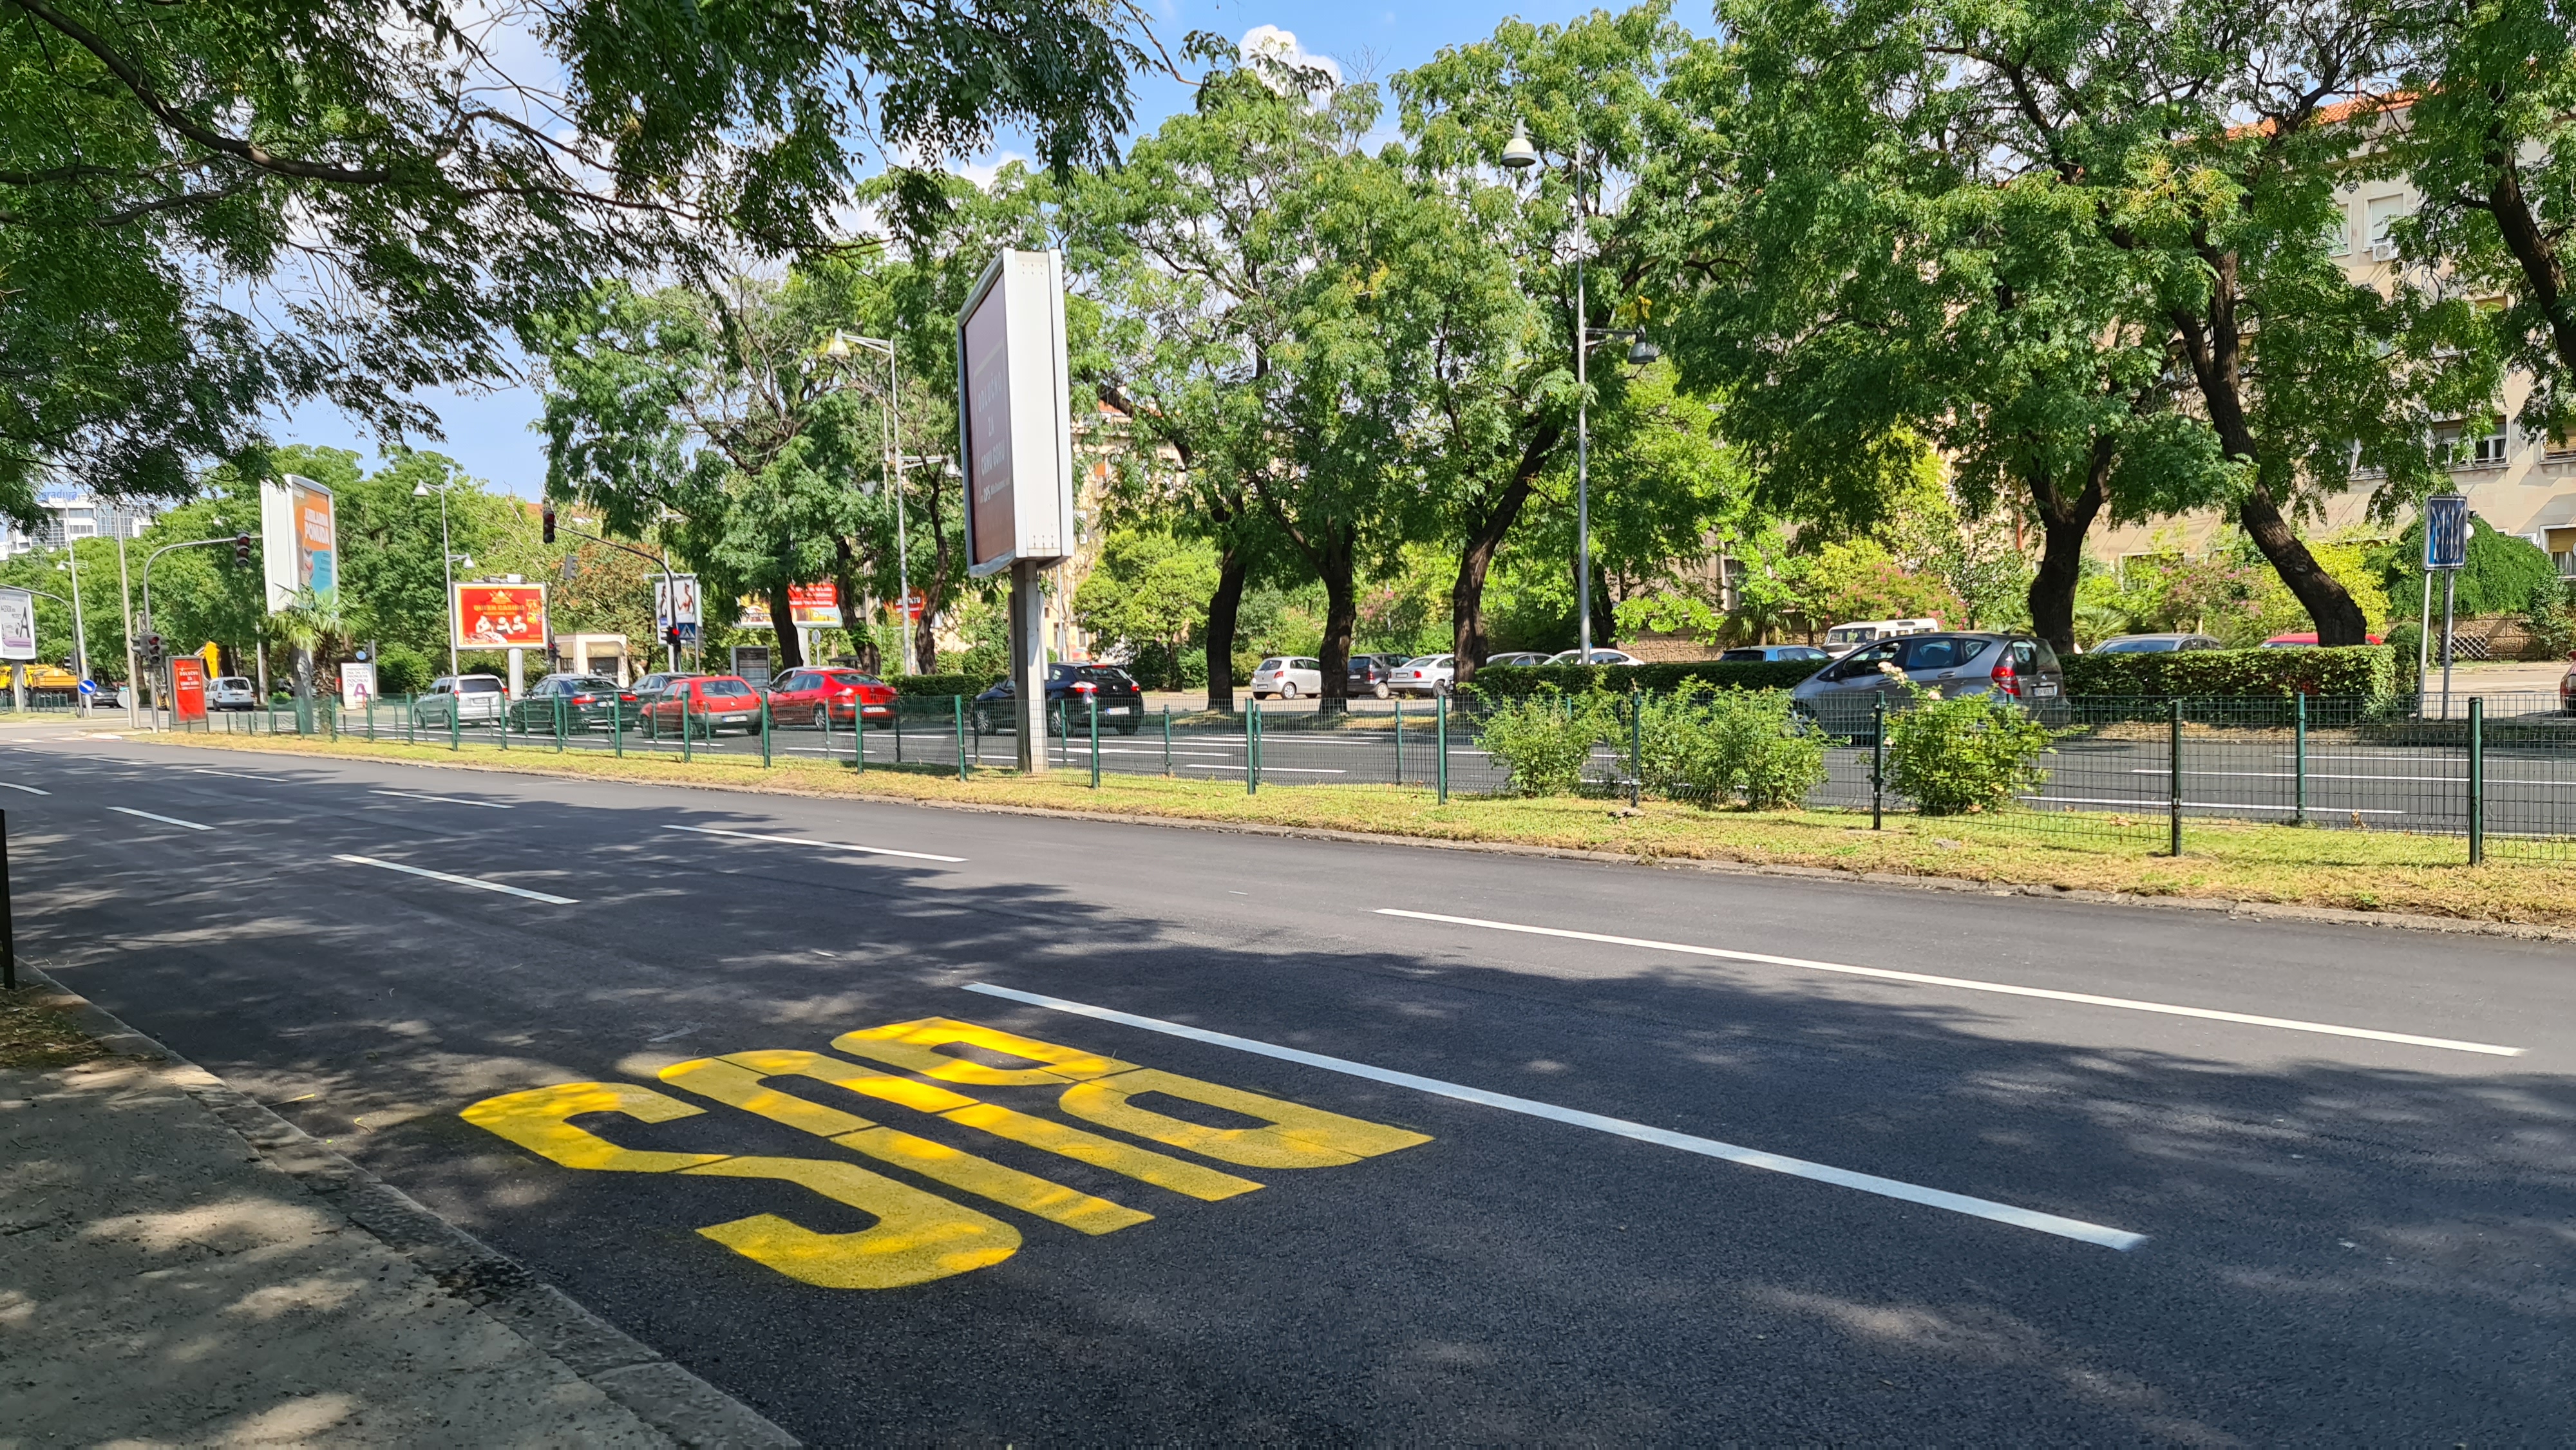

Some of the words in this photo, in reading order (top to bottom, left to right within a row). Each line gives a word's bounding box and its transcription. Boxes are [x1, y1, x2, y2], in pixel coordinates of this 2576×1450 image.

[978, 371, 1002, 413] ODLUČNO
[987, 414, 995, 437] ZA
[304, 520, 330, 545] PONUDA
[459, 1015, 1435, 1289] BUS
